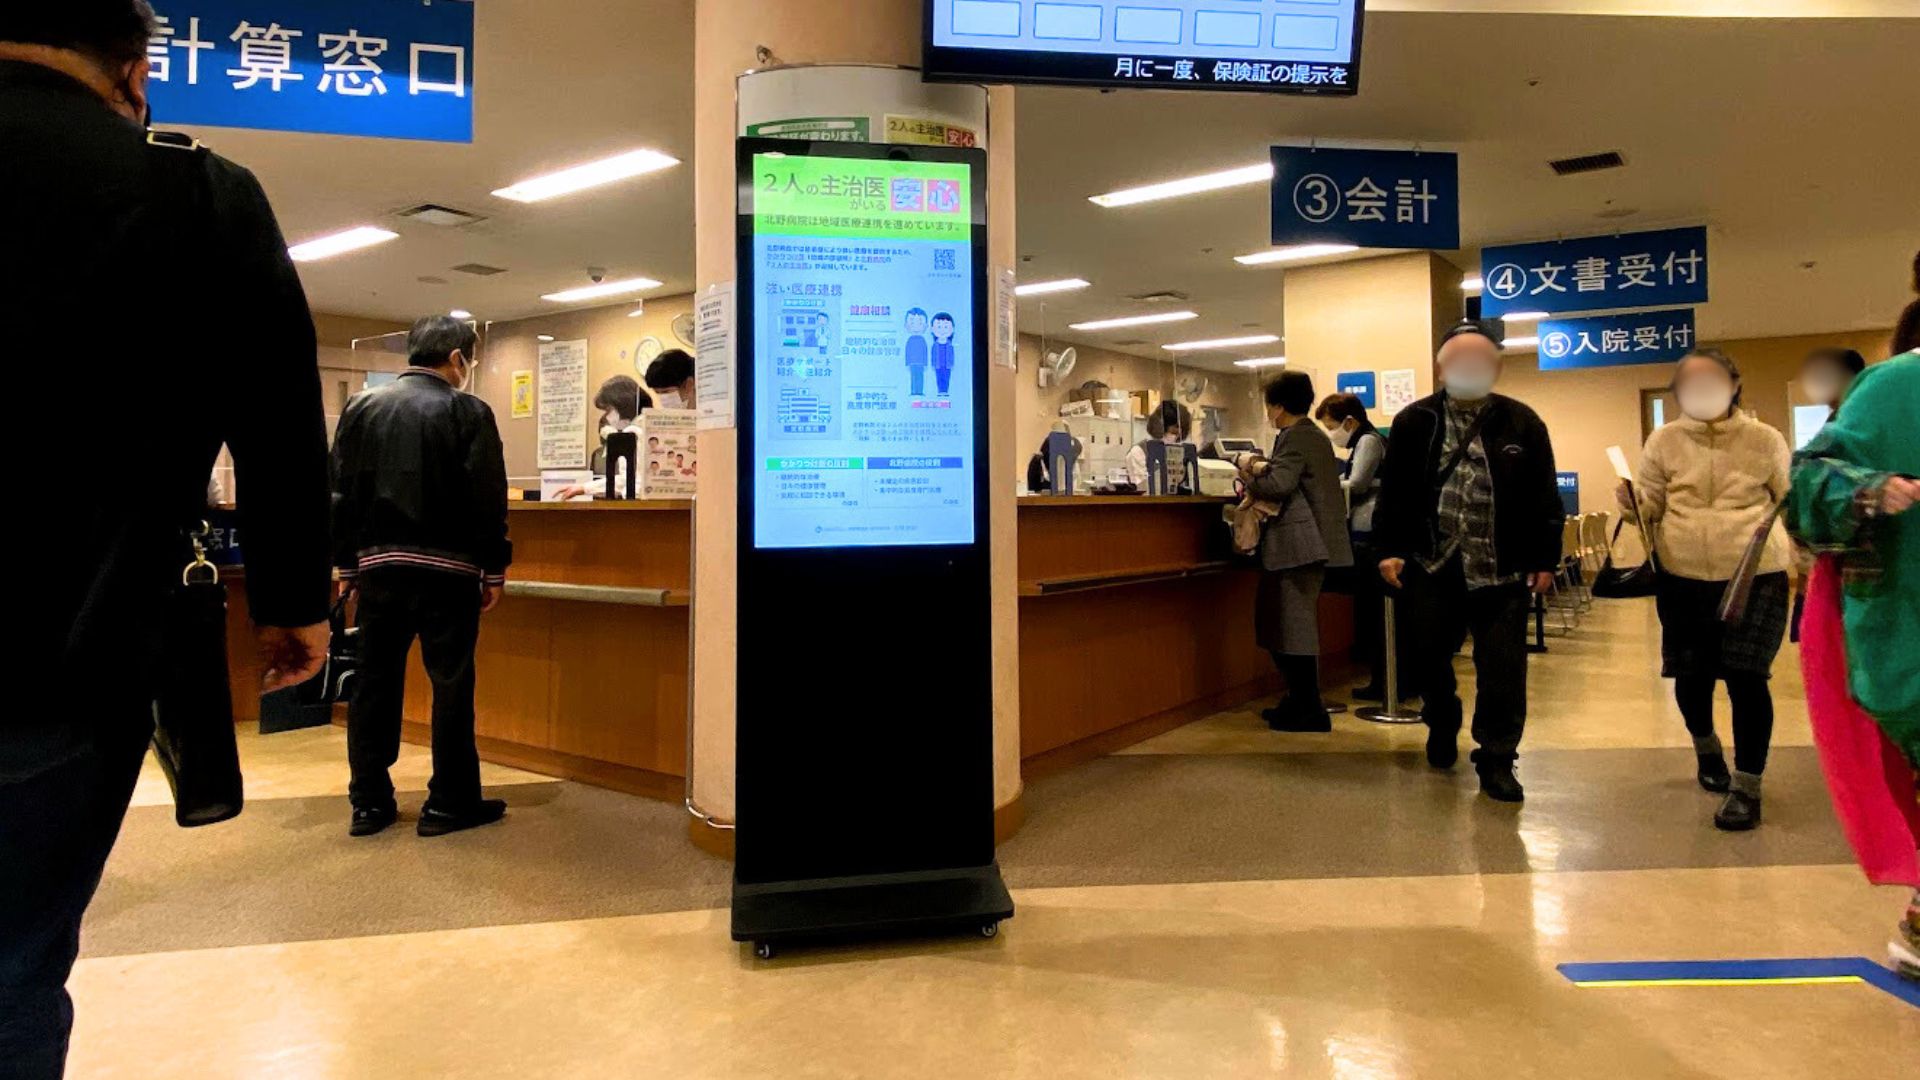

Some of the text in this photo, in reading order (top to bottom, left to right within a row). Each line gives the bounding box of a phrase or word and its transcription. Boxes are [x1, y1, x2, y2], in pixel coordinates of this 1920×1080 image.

[147, 16, 465, 98] 計算窓口
[1114, 57, 1348, 85] 月に一度、保険証の提示を
[849, 199, 887, 212] がいる
[891, 177, 961, 213] 安心
[764, 214, 961, 231] 北野病院は地域医療連携を進めています。
[1486, 248, 1703, 300] ④文書受付
[1541, 323, 1693, 359] ⑤入院受付
